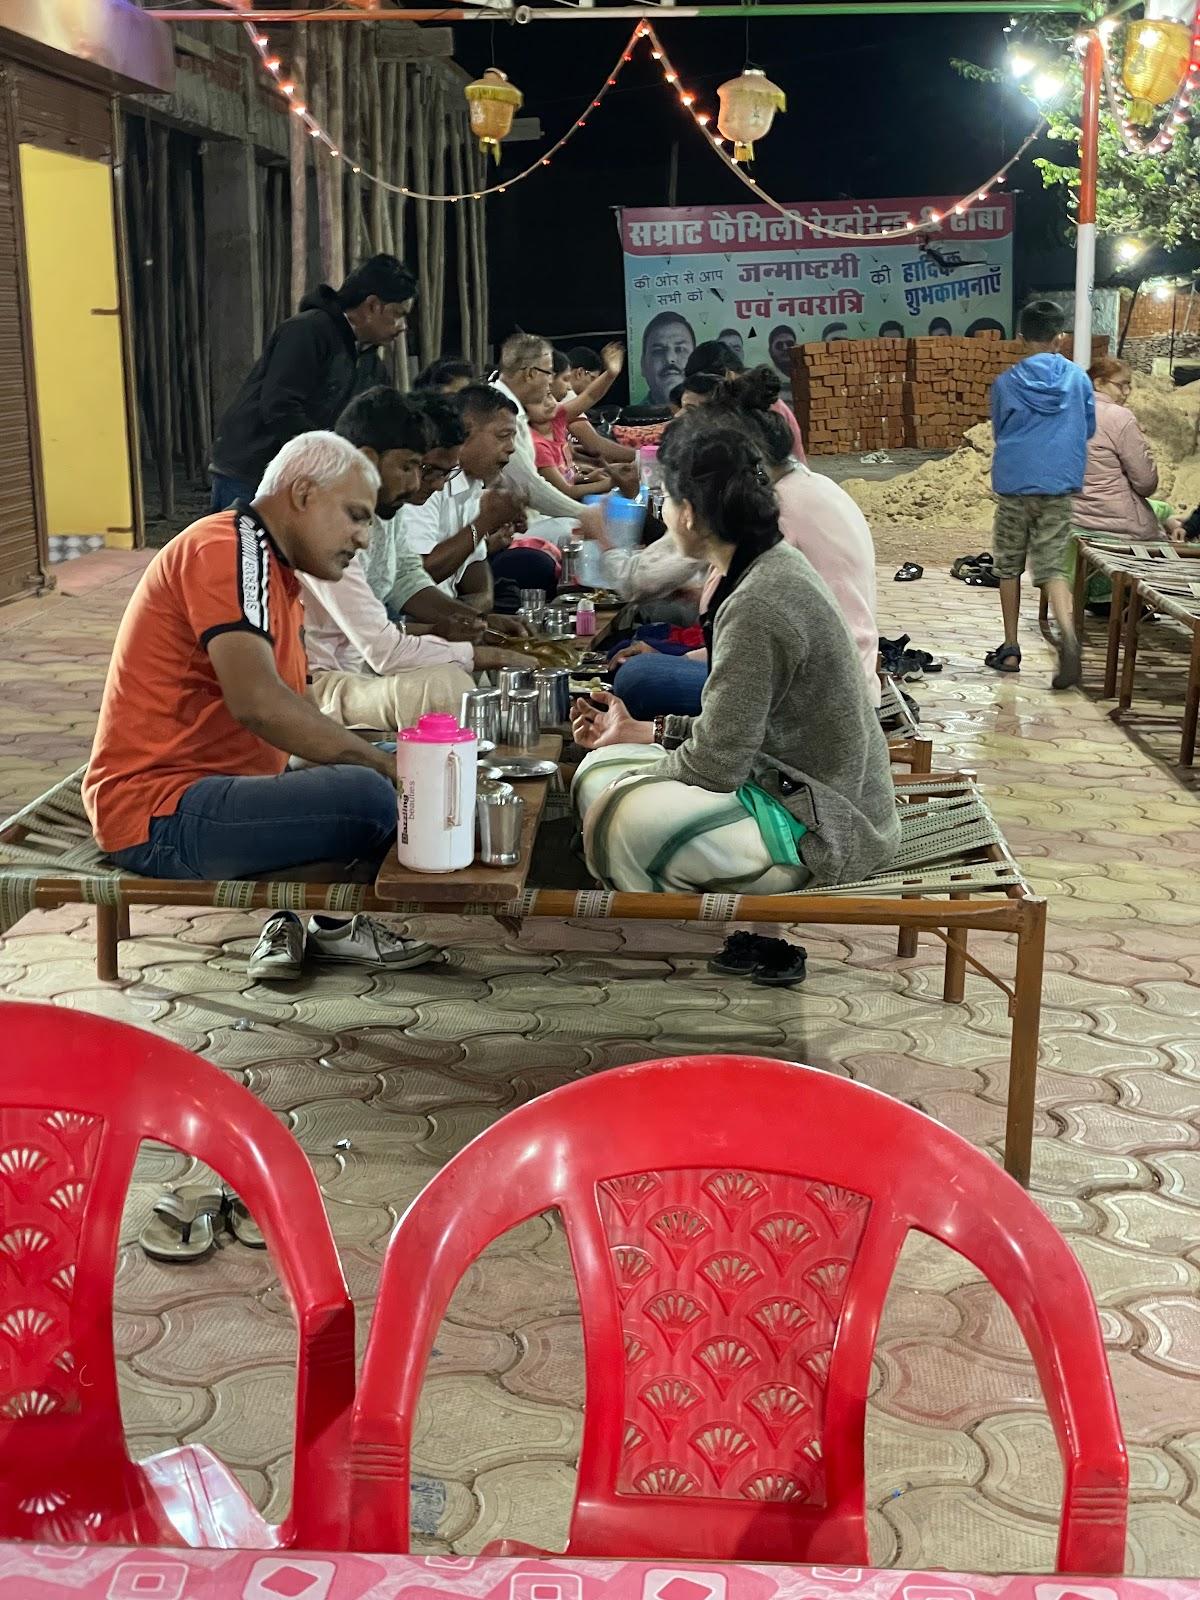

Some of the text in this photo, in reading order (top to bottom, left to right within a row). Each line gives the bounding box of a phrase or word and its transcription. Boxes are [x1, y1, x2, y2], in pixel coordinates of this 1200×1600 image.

[627, 219, 704, 247] सम्राट
[708, 209, 805, 244] फैमिली
[950, 205, 1006, 232] ढाबा
[633, 269, 724, 290] की ओर से आप
[737, 252, 861, 283] जन्माष्टमी
[869, 264, 893, 285] की
[657, 288, 704, 306] सभी को
[734, 288, 865, 320] एवं नवरात्रि
